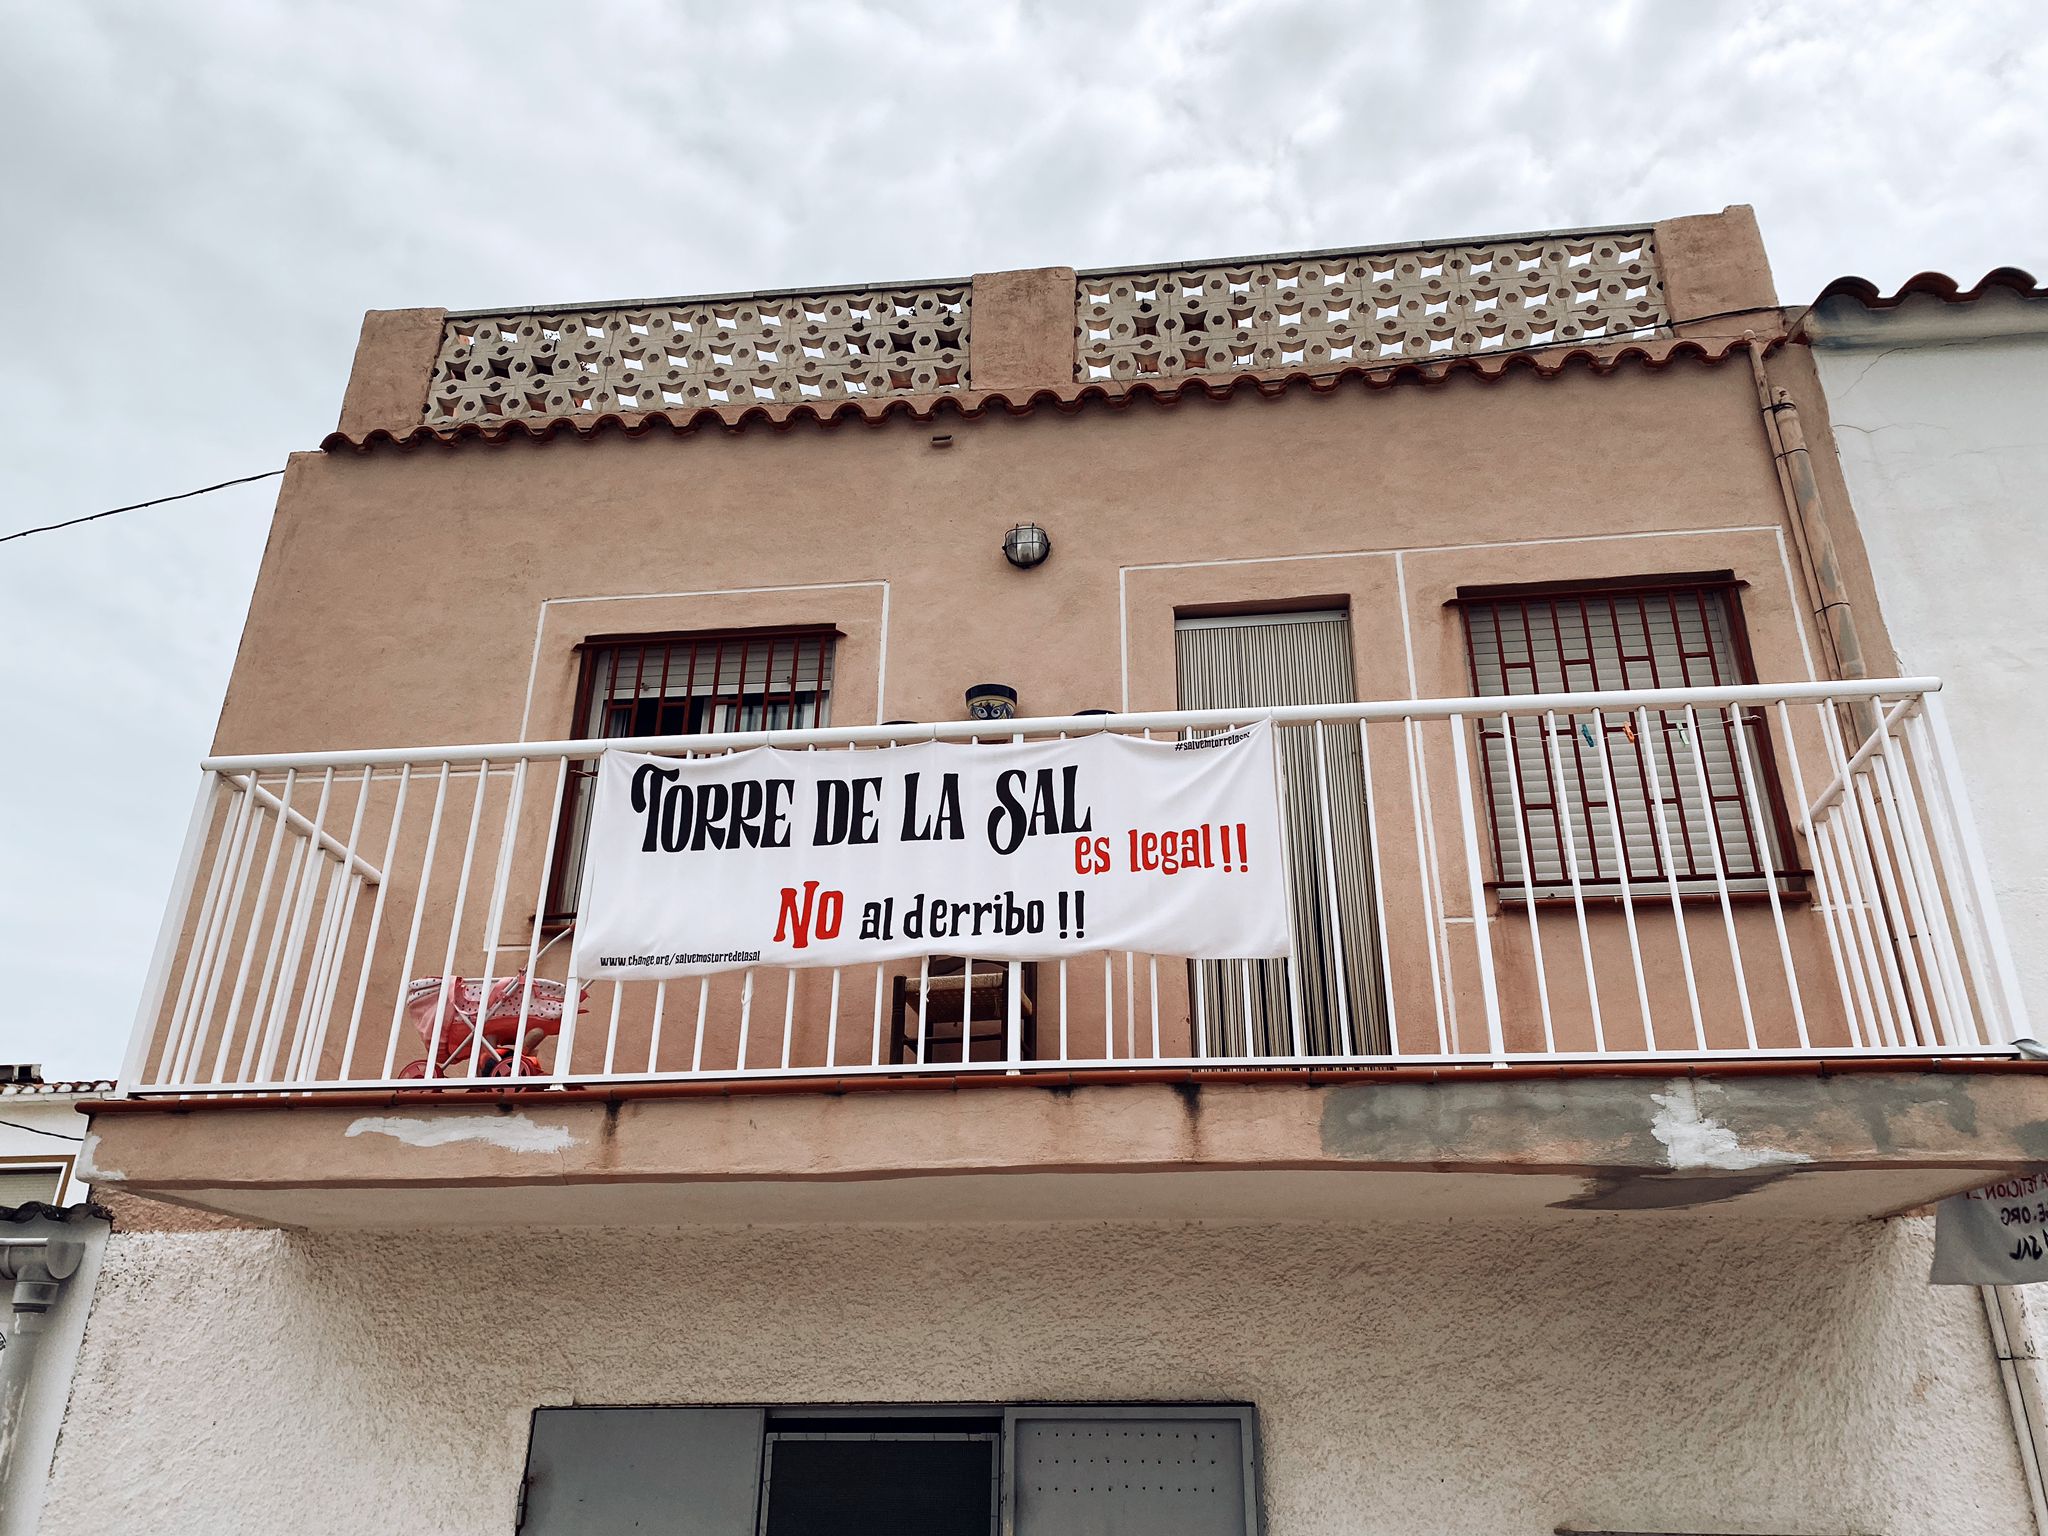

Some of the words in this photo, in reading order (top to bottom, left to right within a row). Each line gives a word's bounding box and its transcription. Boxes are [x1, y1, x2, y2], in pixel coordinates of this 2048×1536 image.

[631, 764, 795, 853] TORRE
[813, 777, 882, 846] DE
[901, 772, 964, 841] LA
[987, 765, 1092, 855] SAL
[1075, 836, 1110, 875] es
[859, 897, 894, 941] al
[903, 890, 1044, 939] derribo
[600, 950, 760, 967] www.change.org/salvemostorredelasal
